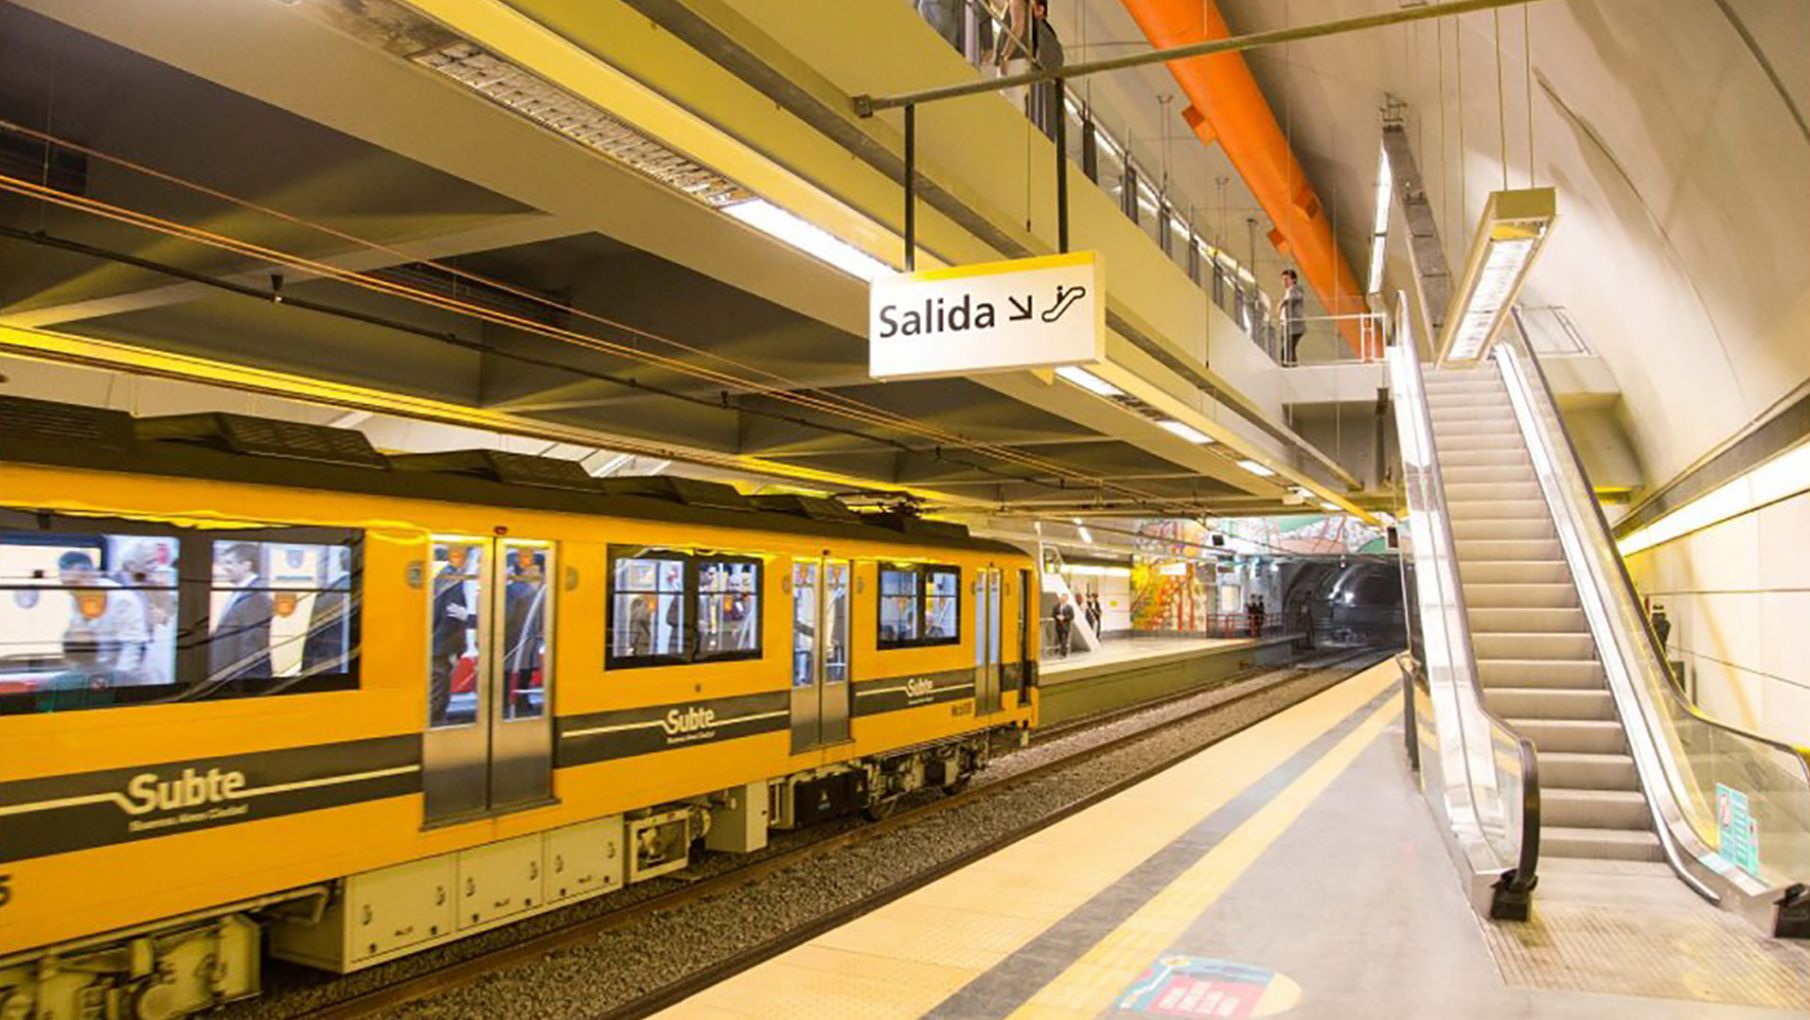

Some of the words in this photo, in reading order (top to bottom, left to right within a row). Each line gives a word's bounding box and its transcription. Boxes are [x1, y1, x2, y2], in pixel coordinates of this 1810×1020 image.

[879, 294, 995, 338] Salida
[667, 707, 715, 734] Subte
[127, 767, 246, 815] Subte
